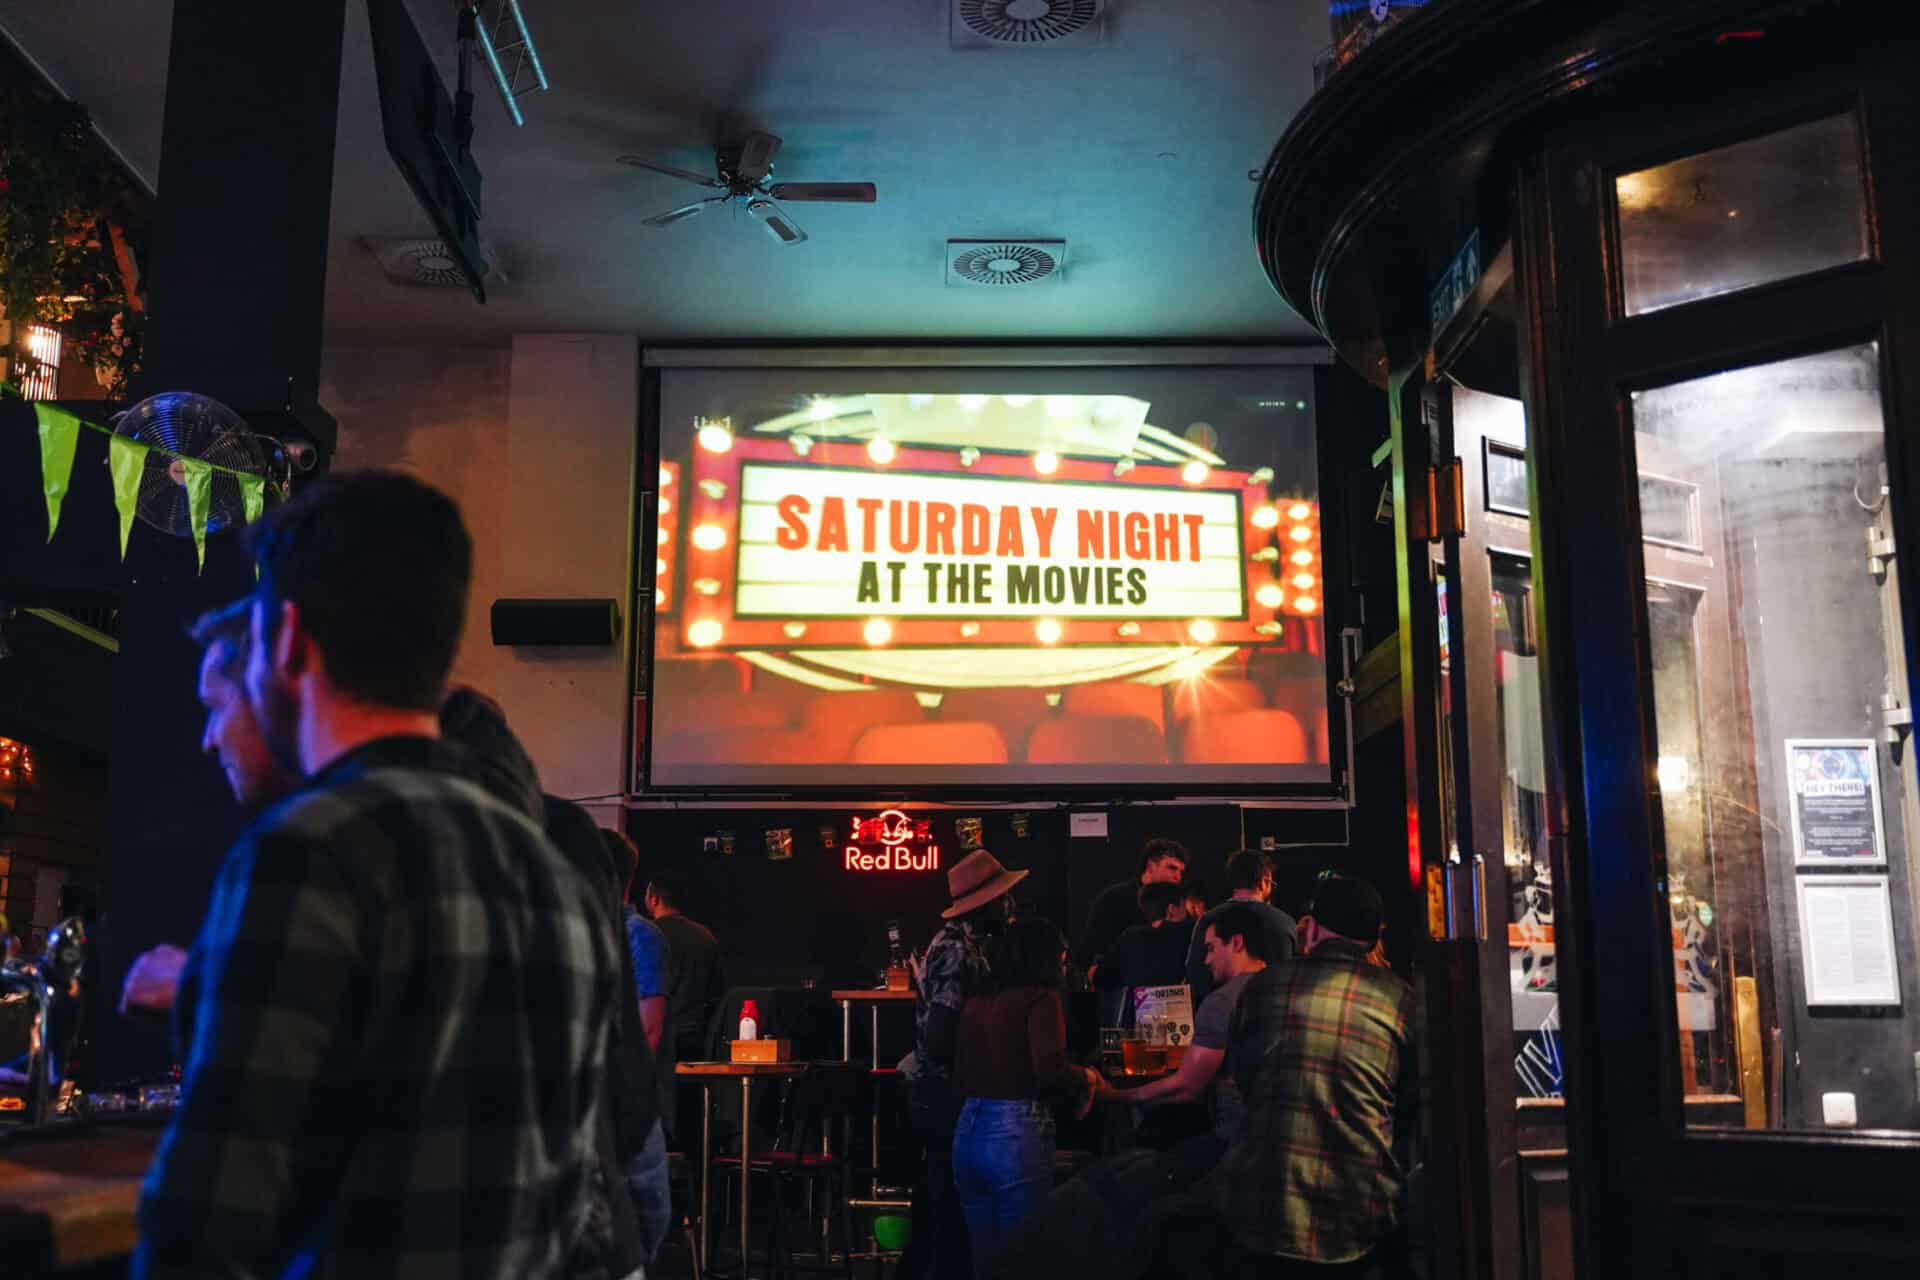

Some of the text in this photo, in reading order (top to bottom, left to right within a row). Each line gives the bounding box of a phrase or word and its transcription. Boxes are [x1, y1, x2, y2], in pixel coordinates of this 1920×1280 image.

[776, 494, 1204, 562] SATURDAY NIGHT
[856, 561, 1147, 605] AT THE MOVIES
[846, 846, 938, 870] Red Bull
